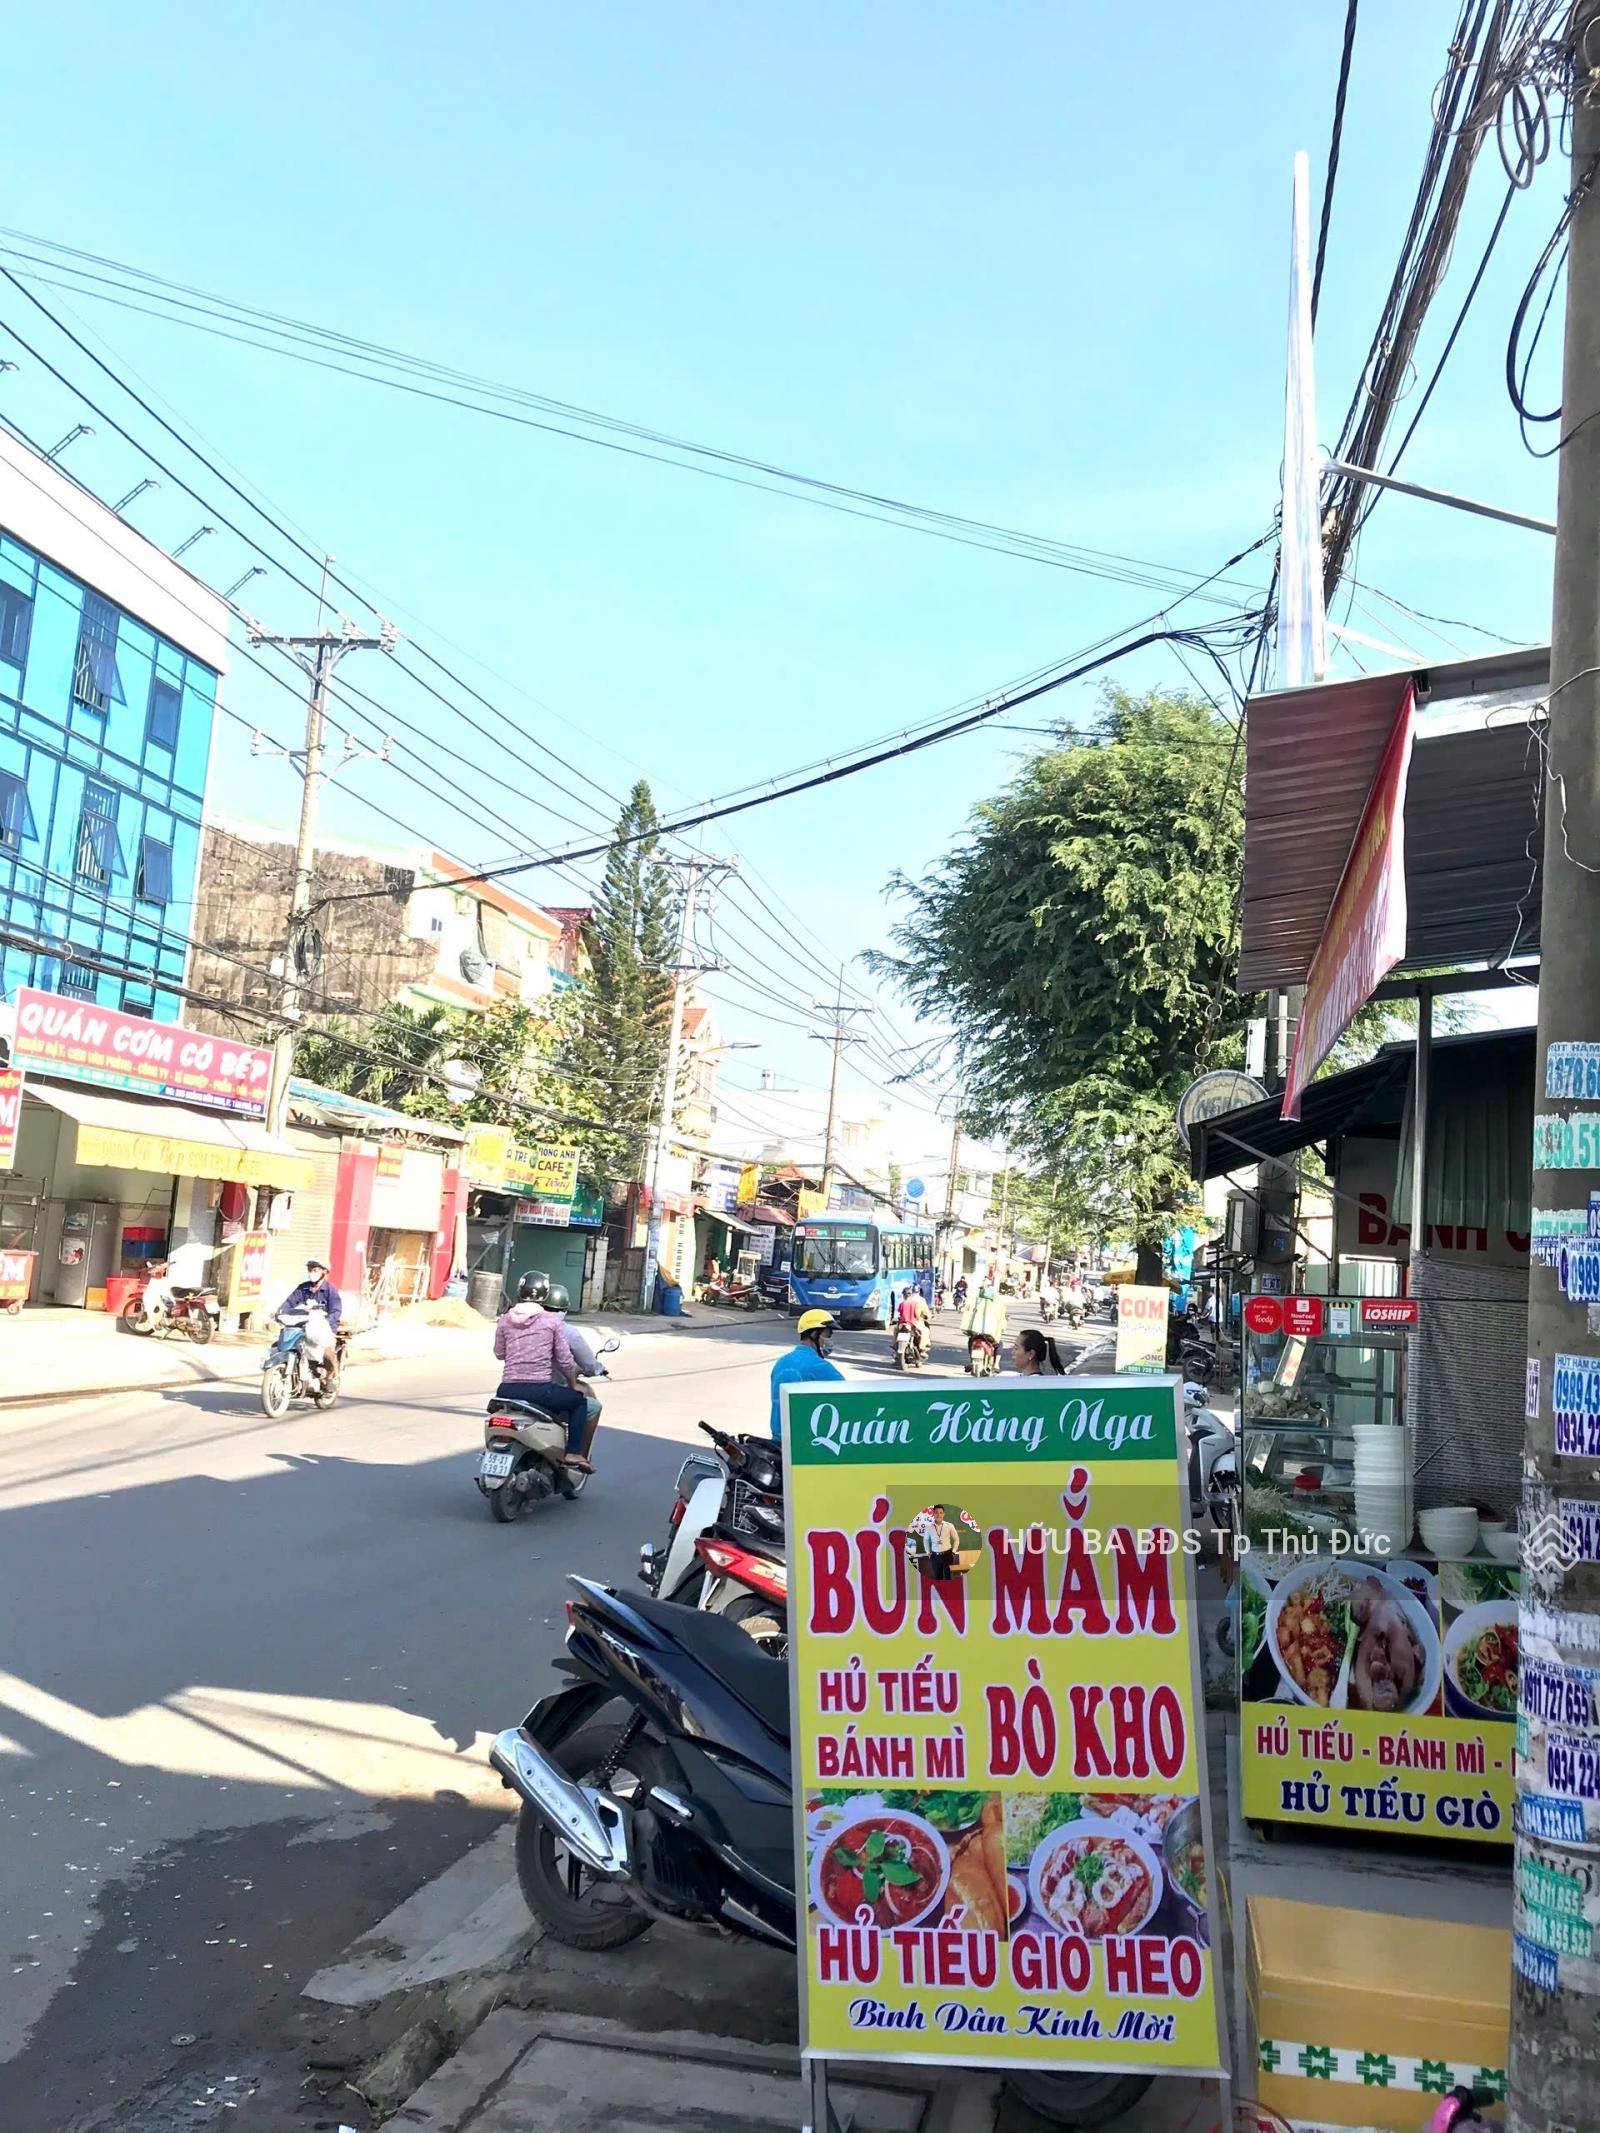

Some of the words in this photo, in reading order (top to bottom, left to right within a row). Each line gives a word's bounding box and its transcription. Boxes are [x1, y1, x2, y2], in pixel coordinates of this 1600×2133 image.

[21, 1003, 108, 1047] QUÁN
[113, 1026, 174, 1062] CƠM
[180, 1040, 214, 1072] CÔ
[537, 1160, 564, 1173] CAFE
[1365, 1308, 1412, 1321] LOSHIP
[810, 1402, 914, 1456] Quán
[926, 1399, 1048, 1452] Hằng
[1059, 1398, 1157, 1451] Nga
[808, 1498, 967, 1635] BÚN
[988, 1467, 1177, 1635] MẮM
[820, 1656, 866, 1713] HỦ
[878, 1654, 958, 1714] TIẾU
[986, 1658, 1057, 1778] BÒ
[1068, 1685, 1186, 1780] KHO
[1257, 1715, 1289, 1756] HỦ
[1298, 1720, 1353, 1762] TIẾU
[1378, 1730, 1446, 1770] BÁNH
[1456, 1736, 1485, 1774] MÌ
[818, 1726, 914, 1778] BÁNH
[926, 1726, 965, 1779] MÌ
[1281, 1770, 1330, 1813] HỦ
[1340, 1776, 1426, 1822] TIẾU
[1436, 1790, 1500, 1830] GIÒ
[819, 1907, 879, 1982] HỦ
[894, 1908, 997, 1988] TIẾU
[1010, 1920, 1091, 1992] GIÒ
[1106, 1935, 1201, 1998] HEO
[850, 1999, 926, 2029] Bình
[935, 2002, 1008, 2034] Dân
[1016, 2005, 1101, 2038] Kính
[1108, 2009, 1176, 2042] Mời
